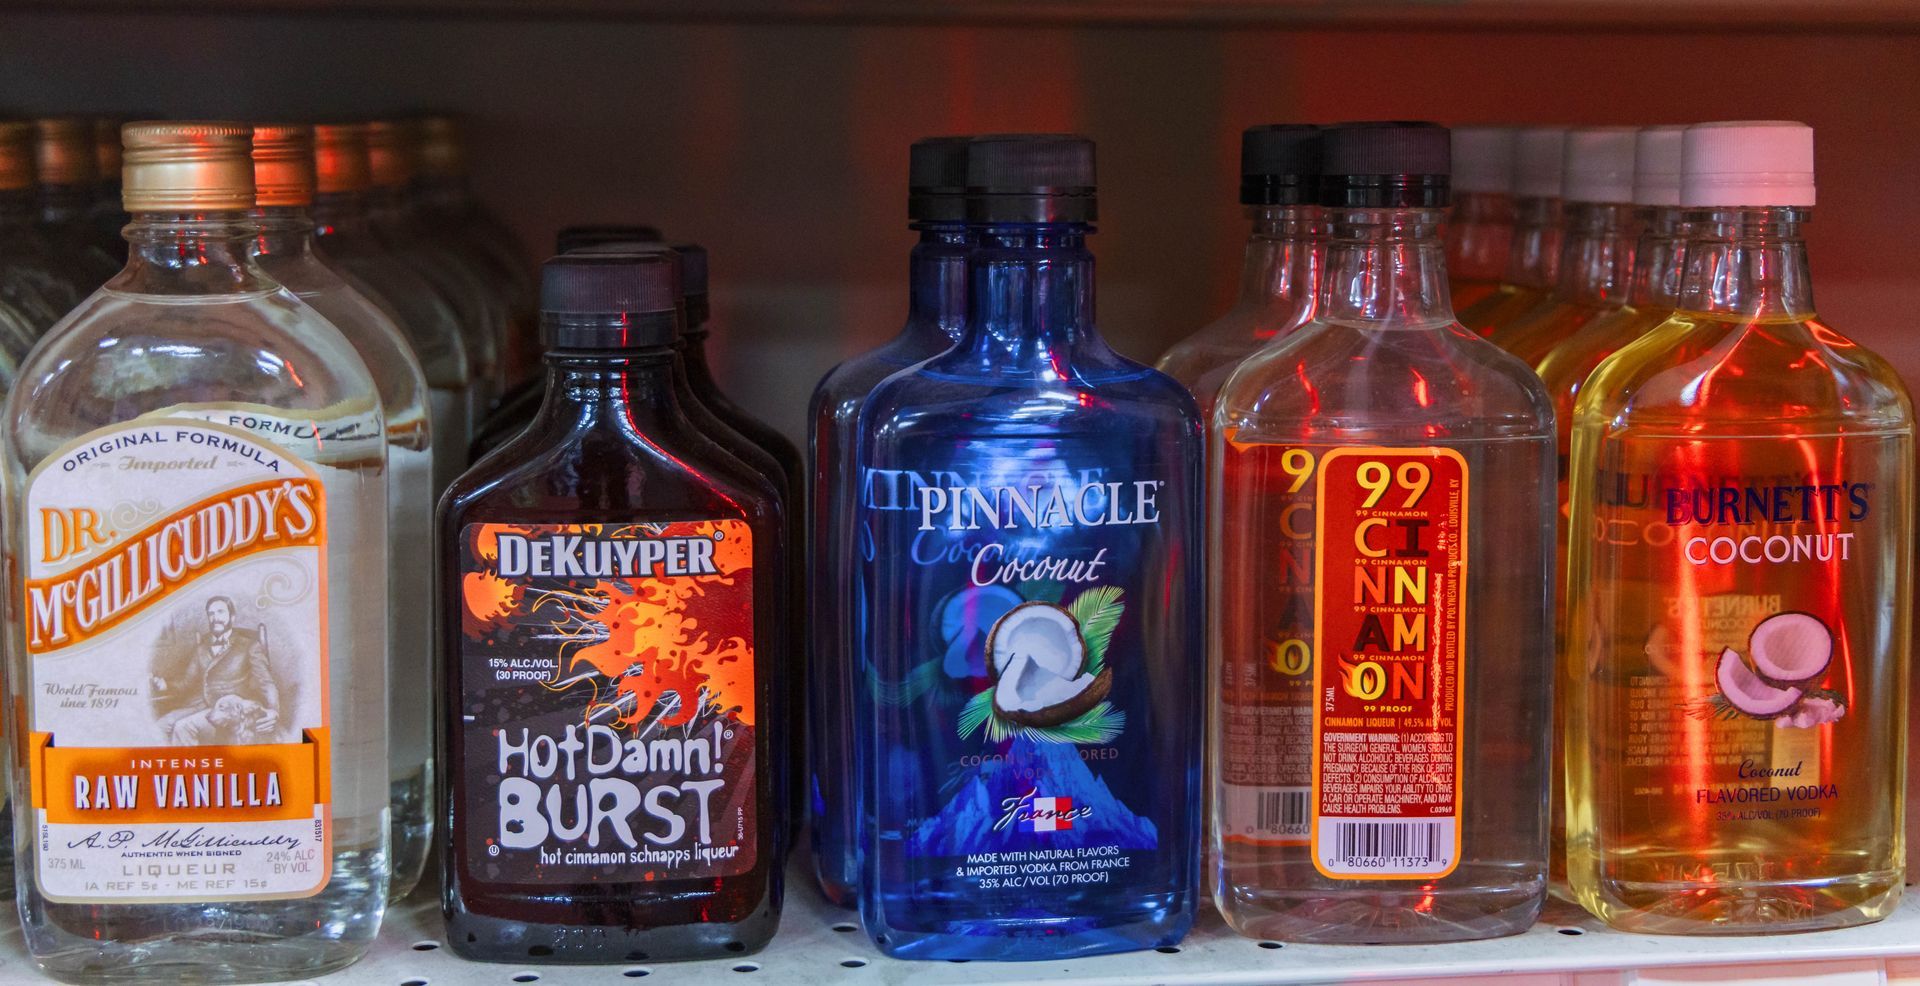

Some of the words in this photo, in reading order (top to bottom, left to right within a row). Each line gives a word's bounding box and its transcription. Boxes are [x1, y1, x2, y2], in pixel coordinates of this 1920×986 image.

[63, 431, 168, 473] ORIGINAL
[176, 430, 281, 473] FORMULA
[118, 455, 219, 474] Imported
[1355, 461, 1432, 509] 99
[1449, 479, 1459, 488] KY
[917, 479, 1161, 531] PINNACLE
[1448, 490, 1459, 527] LOUISVILLE,
[1666, 481, 1869, 526] BURNETT'S
[39, 508, 117, 564] DR.
[1685, 533, 1854, 565] COCONUT
[971, 542, 1108, 587] Coconut
[1446, 579, 1457, 619] POLYNESIAN
[1447, 620, 1456, 629] BY
[1446, 631, 1456, 659] BOTTLED
[488, 658, 508, 668] 15%
[1446, 660, 1456, 675] AND
[496, 670, 511, 681] (30
[512, 670, 552, 681] PROOF)
[43, 682, 85, 696] World
[87, 683, 139, 699] Famous
[1445, 676, 1455, 711] PRODUCED
[60, 698, 88, 709] since
[89, 697, 119, 710] 1891
[1380, 705, 1413, 713] PROOF
[1325, 718, 1364, 727] CINNAMON
[1366, 718, 1395, 727] LIQUEUR
[1403, 718, 1424, 727] 49.5%
[1324, 732, 1367, 743] GOVERNMENT
[1368, 732, 1400, 743] WARNING:
[1401, 732, 1409, 743] (1)
[1446, 732, 1453, 743] TO
[1324, 743, 1336, 753] THE
[1337, 743, 1368, 753] SURGEON
[1402, 743, 1427, 753] WOMEN
[131, 758, 225, 769] INTENSE
[1323, 753, 1336, 763] NOT
[1338, 753, 1357, 763] DRINK
[1358, 753, 1393, 763] ALCOHOLIC
[1394, 753, 1429, 763] BEVERAGES
[1431, 753, 1453, 763] DURING
[1323, 763, 1359, 774] PREGNANCY
[1360, 763, 1387, 773] BECAUSE
[1389, 763, 1397, 773] OF
[1399, 763, 1410, 773] THE
[1412, 763, 1425, 773] RISK
[1426, 763, 1434, 773] OF
[1436, 763, 1452, 773] BIRTH
[1738, 758, 1803, 780] Coconut
[1323, 774, 1351, 783] DEFECTS.
[1353, 773, 1362, 783] (2)
[1363, 774, 1408, 783] CONSUMPTION
[1409, 774, 1417, 783] OF
[75, 775, 139, 810] RAW
[154, 771, 282, 809] VANILLA
[1323, 784, 1357, 793] BEVERAGES
[1359, 784, 1384, 793] IMPAIRS
[1384, 784, 1401, 794] YOUR
[1402, 784, 1424, 793] ABILITY
[1425, 784, 1434, 793] TO
[1435, 784, 1452, 793] DRIVE
[1697, 787, 1781, 804] FLAVORED
[1786, 783, 1839, 800] VODKA
[1322, 794, 1328, 803] A
[1329, 794, 1342, 803] CAR
[1343, 794, 1353, 803] OR
[1353, 794, 1383, 803] OPERATE
[1384, 794, 1423, 804] MACHINERY,
[1424, 794, 1438, 803] AND
[1438, 794, 1452, 803] MAY
[499, 777, 725, 849] BURST
[993, 786, 1093, 832] France
[1322, 804, 1342, 813] CAUSE
[1343, 804, 1367, 813] HEALTH
[1368, 804, 1401, 814] PROBLEMS.
[1739, 810, 1773, 820] ALC/VOL
[1791, 807, 1821, 819] PROOF)
[266, 851, 292, 862] 24%
[294, 849, 315, 861] ALC
[541, 846, 562, 865] hot
[566, 848, 626, 866] cinnamon
[630, 845, 691, 869] schnapps
[695, 842, 740, 867] liqueur
[967, 852, 997, 864] MADE
[1000, 851, 1027, 862] WITH
[1029, 849, 1075, 861] NATURAL
[1077, 845, 1119, 858] FLAVORS
[1328, 858, 1334, 867] 0
[1347, 857, 1386, 867] 80660
[1392, 857, 1429, 867] 11373
[1441, 858, 1447, 867] 9
[48, 857, 67, 869] 375
[70, 857, 85, 869] ML
[123, 863, 237, 878] LIQUEUR
[274, 863, 288, 874] BY
[290, 861, 311, 873] VOL
[956, 867, 964, 877] &
[966, 865, 1017, 877] IMPORTED
[1019, 863, 1057, 874] VODKA
[1059, 861, 1089, 872] FROM
[1091, 857, 1130, 869] FRANCE
[85, 881, 98, 891] IA
[106, 881, 135, 890] REF
[177, 880, 195, 889] ME
[205, 879, 234, 888] REF
[979, 878, 999, 889] 35%
[1002, 875, 1050, 888] ALC/VOL
[1052, 874, 1069, 887] (70
[1071, 871, 1109, 885] PROOF)
